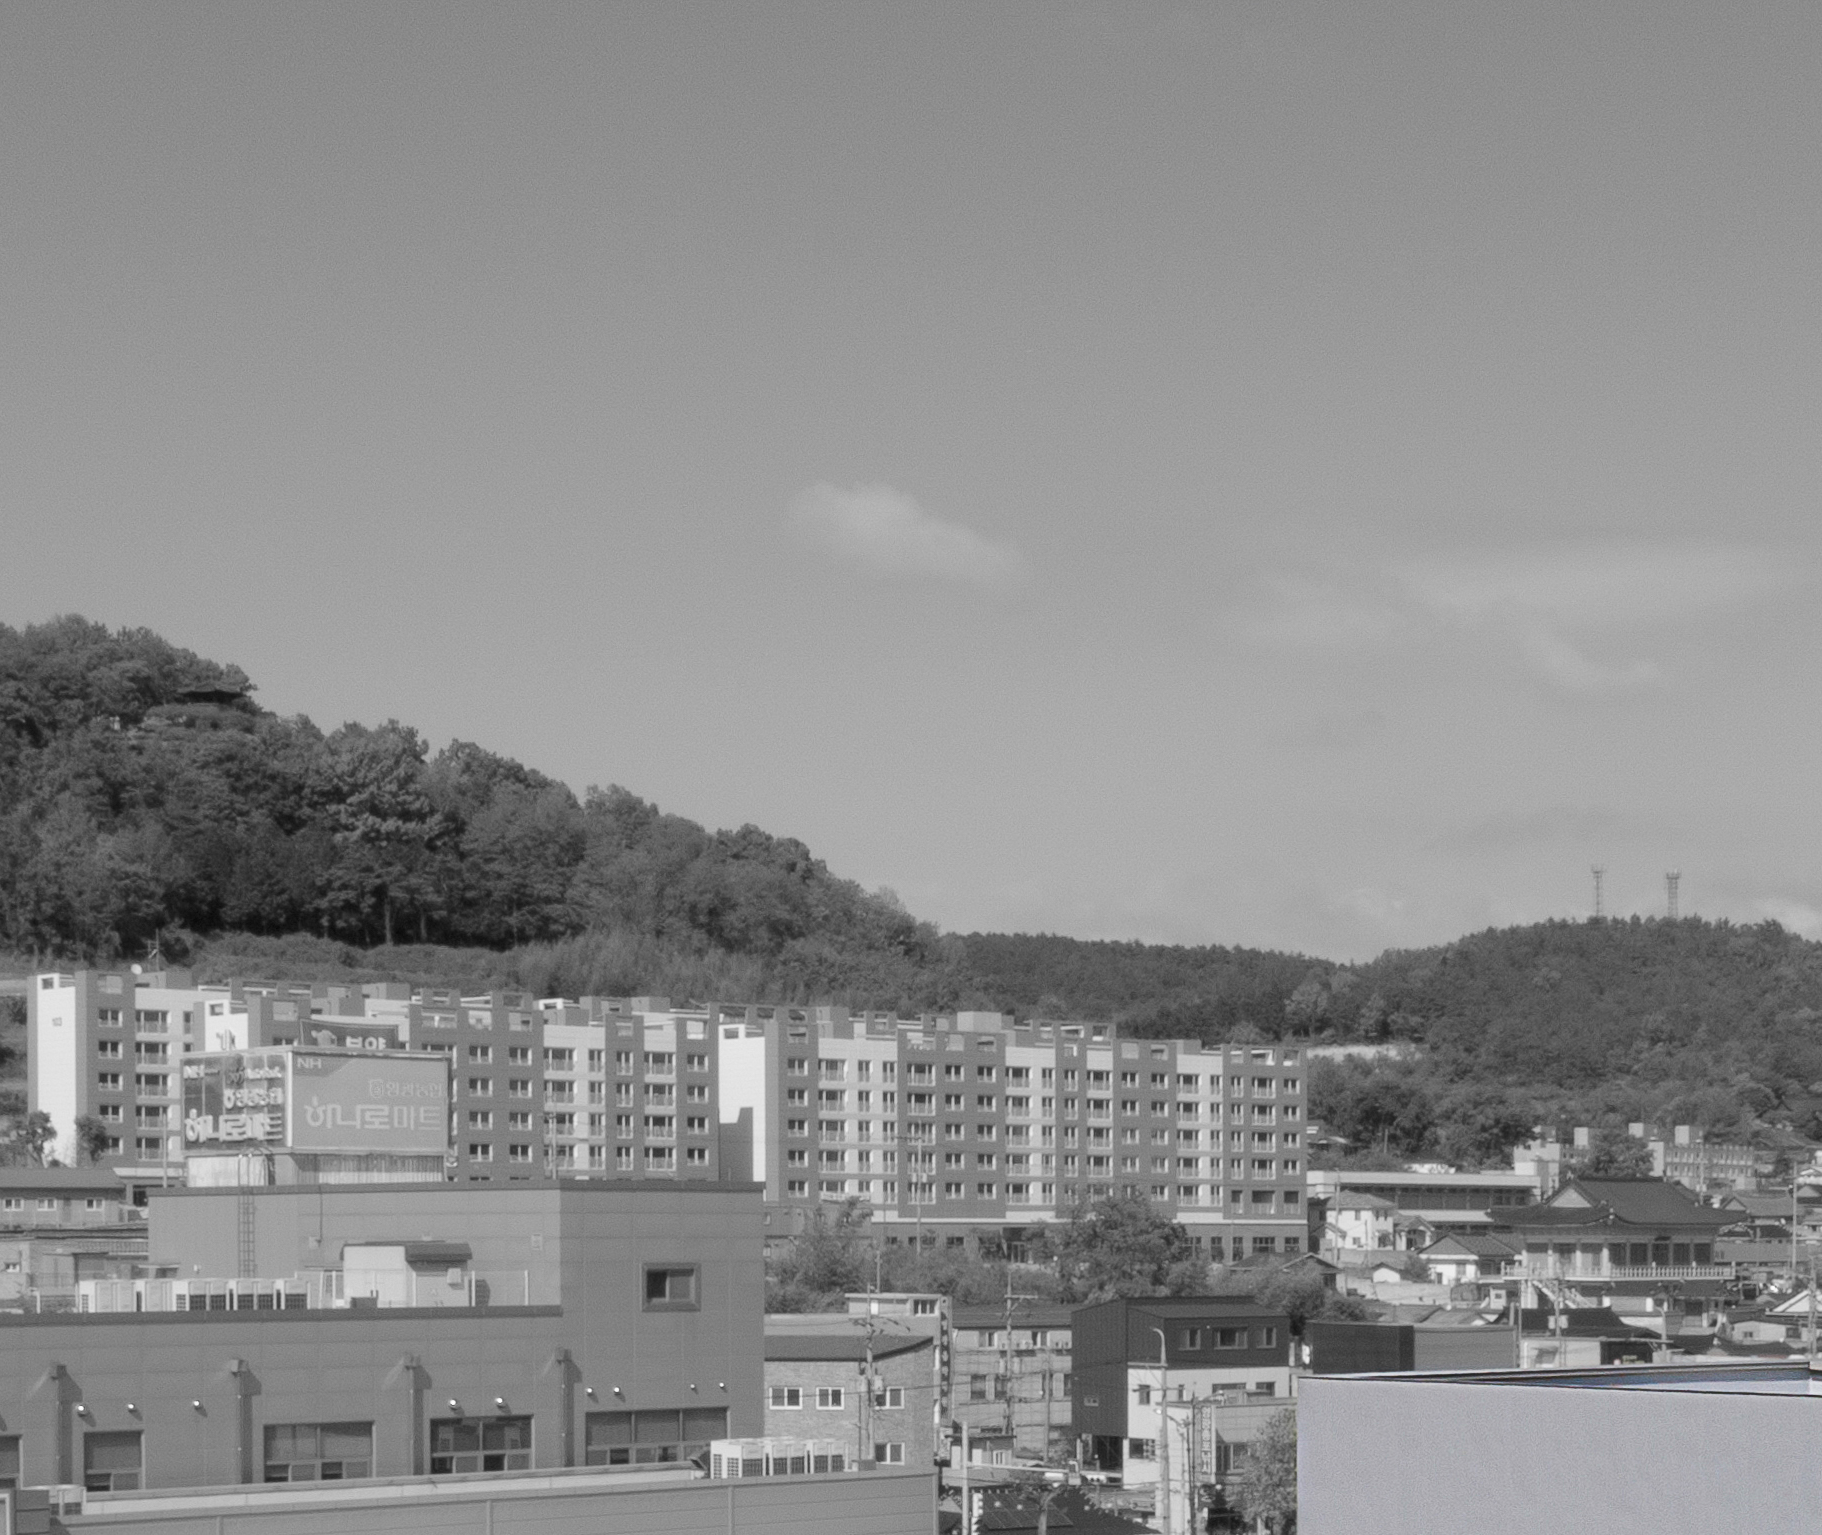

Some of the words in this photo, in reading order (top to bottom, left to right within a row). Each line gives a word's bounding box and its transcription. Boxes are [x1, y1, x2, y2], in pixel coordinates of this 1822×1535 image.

[297, 1057, 322, 1069] NH
[185, 1108, 283, 1142] 하나로마트
[304, 1096, 442, 1131] 하나로마트
